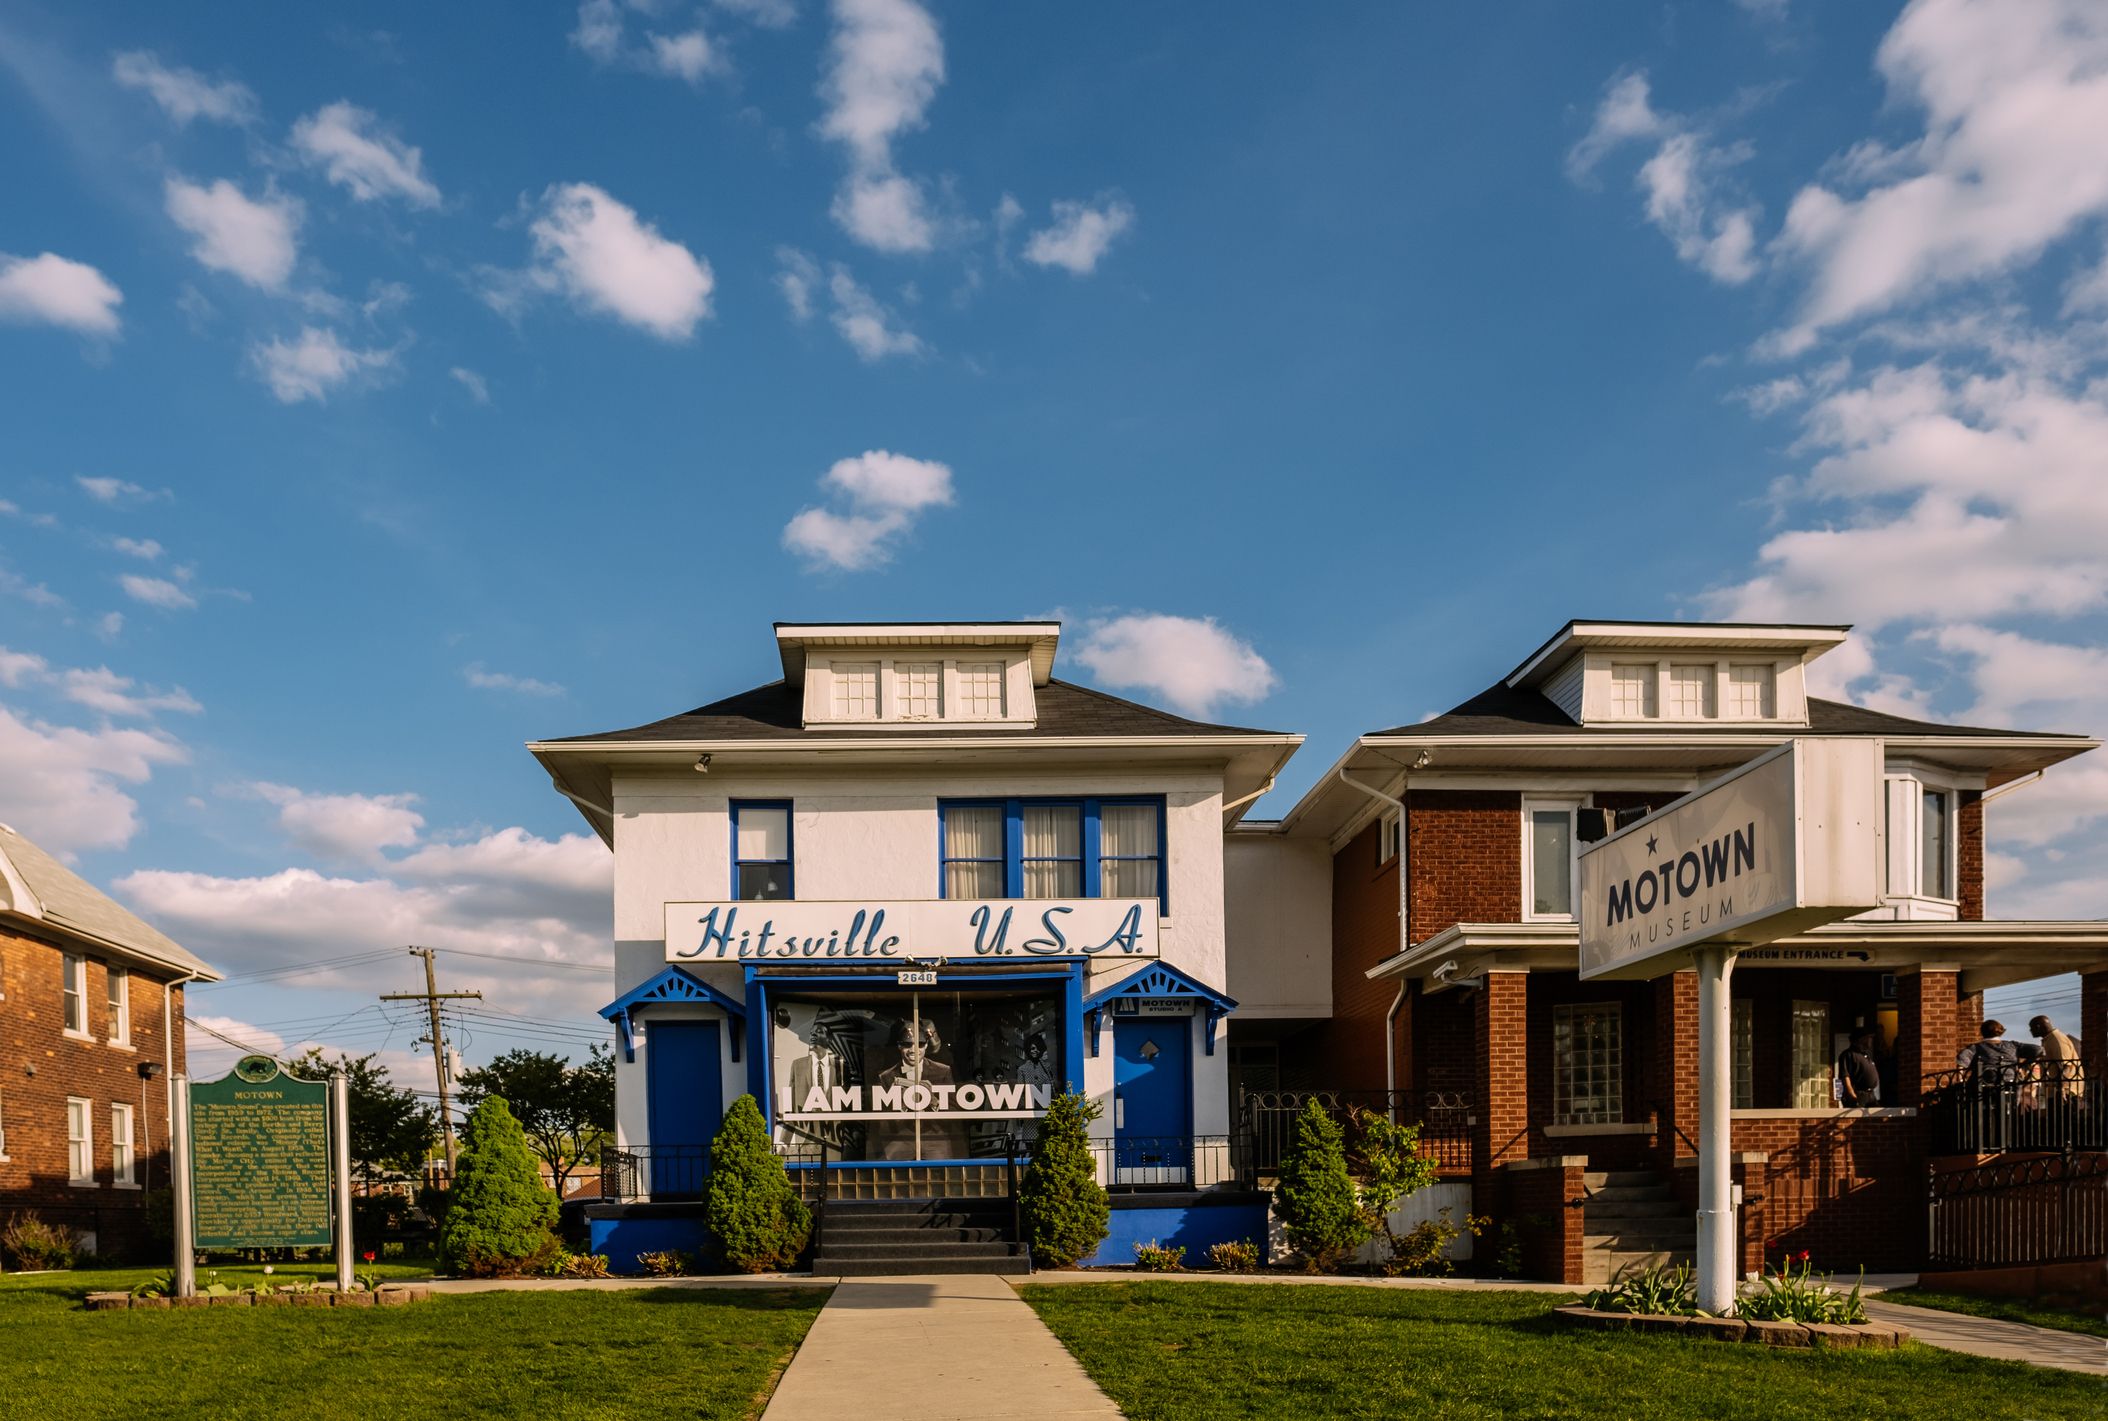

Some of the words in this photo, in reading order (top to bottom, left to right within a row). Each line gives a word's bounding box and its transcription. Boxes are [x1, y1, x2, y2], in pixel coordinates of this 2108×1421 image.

[1607, 822, 1755, 927] MOTOWN
[676, 906, 900, 958] Hitsville
[1629, 896, 1733, 950] MUSEUM
[1738, 950, 1780, 960] MUSEUM
[1783, 950, 1844, 960] ENTRANCE
[234, 1091, 283, 1100] MOTOWN
[782, 1086, 793, 1112] I
[802, 1086, 862, 1112] AM
[872, 1083, 1051, 1111] MOTOWN
